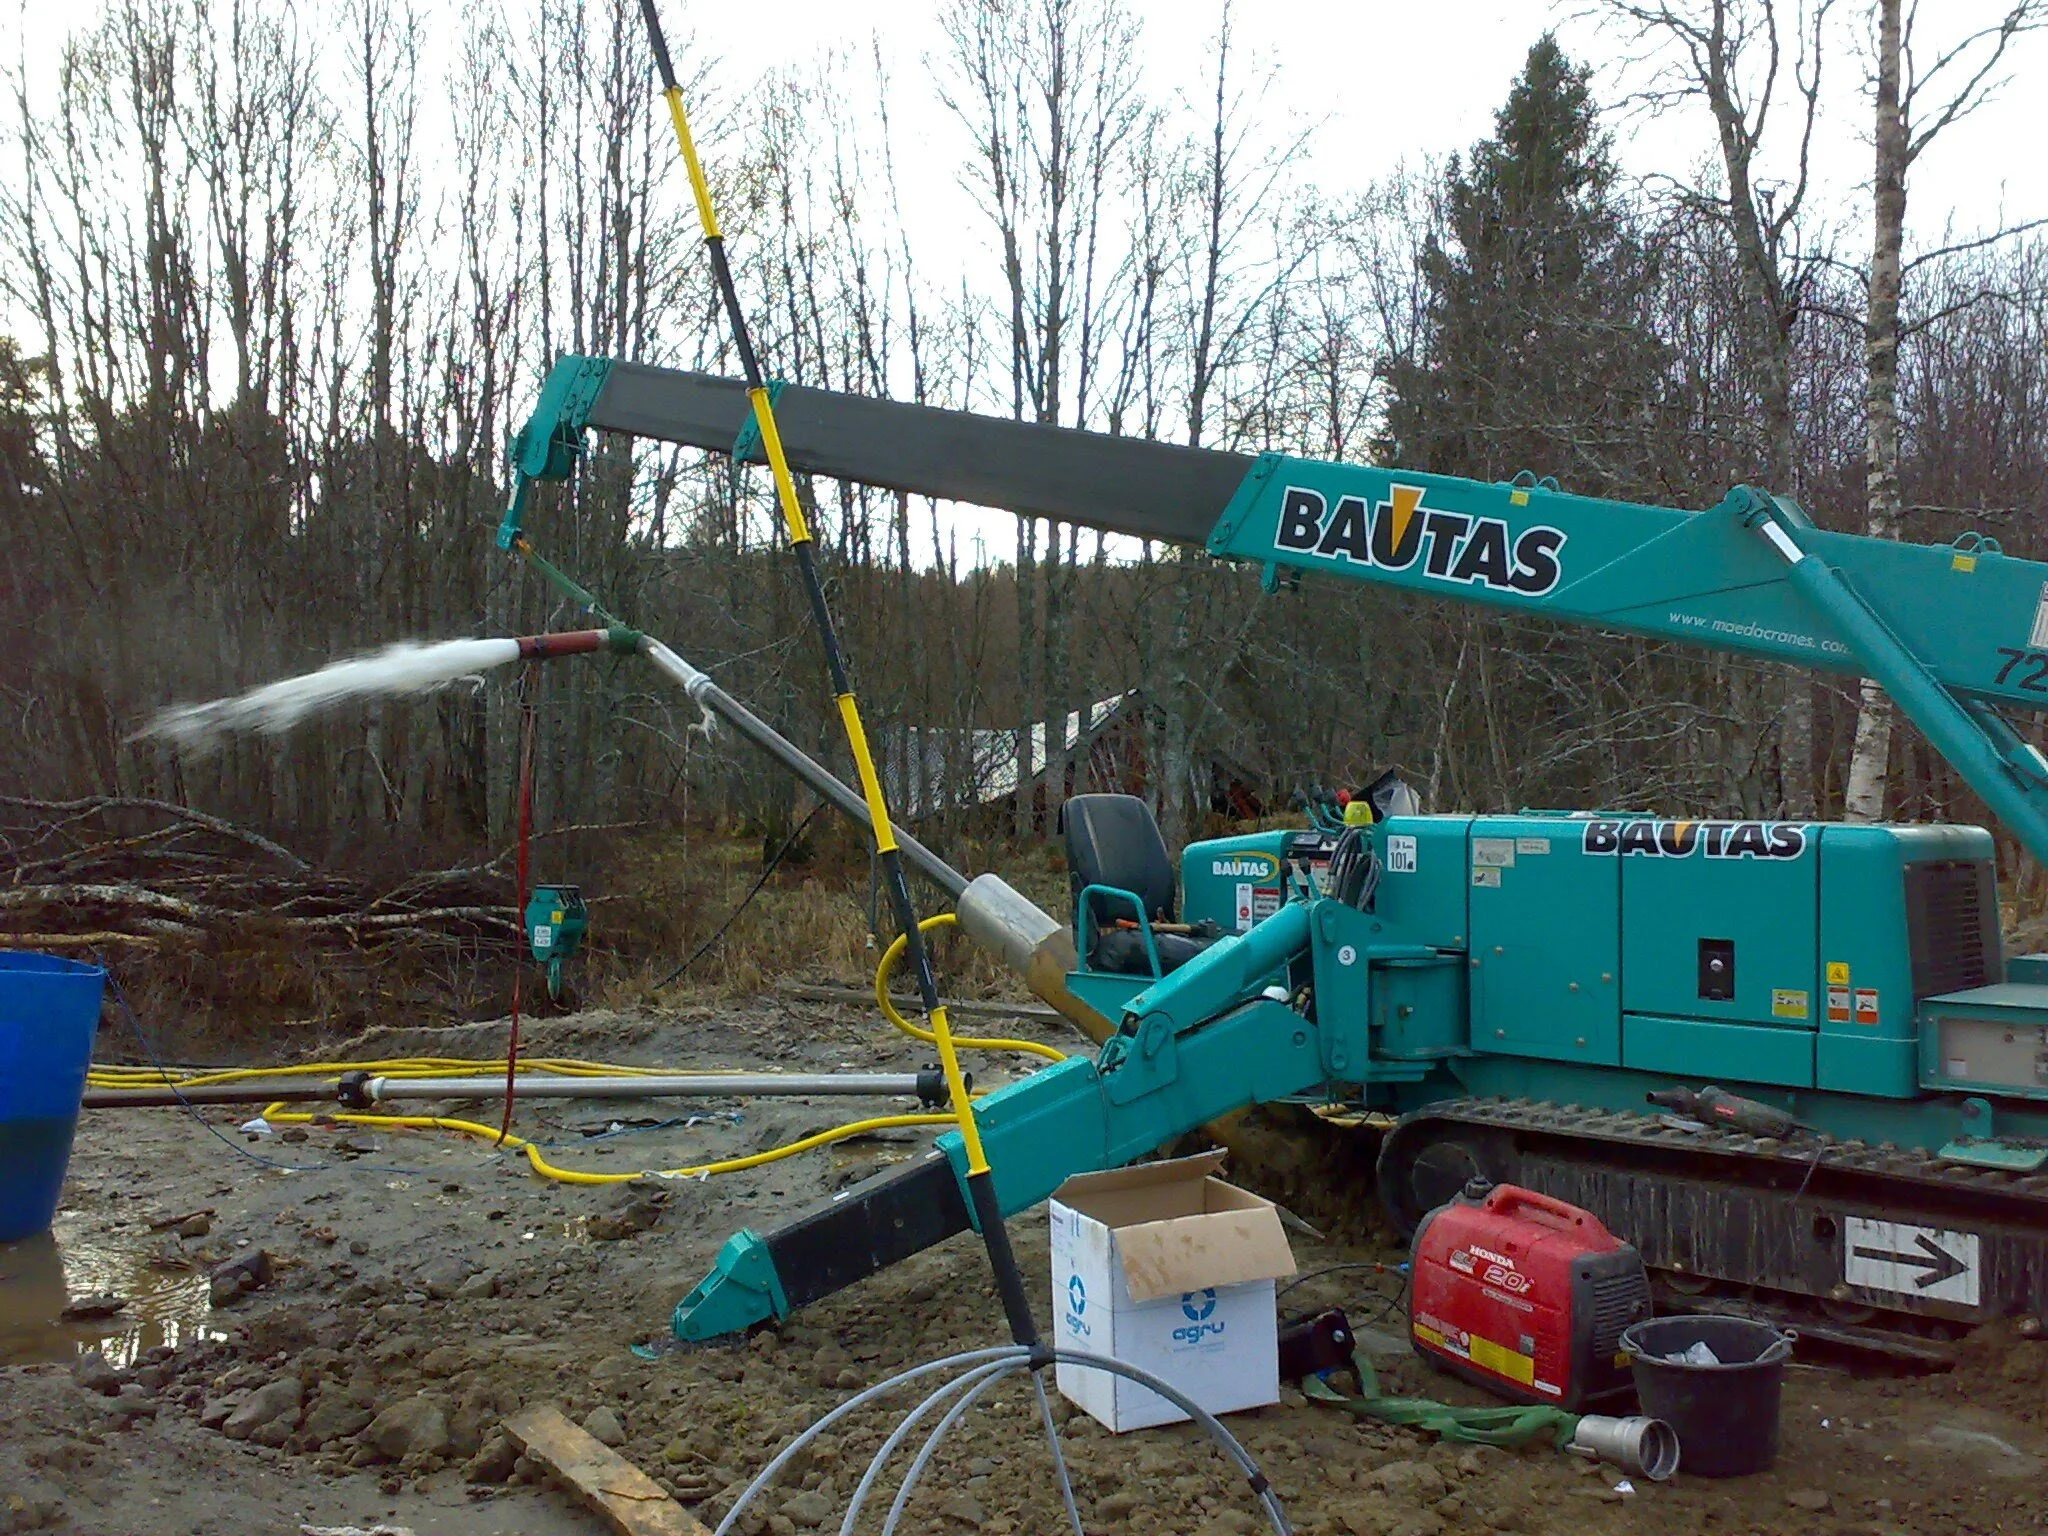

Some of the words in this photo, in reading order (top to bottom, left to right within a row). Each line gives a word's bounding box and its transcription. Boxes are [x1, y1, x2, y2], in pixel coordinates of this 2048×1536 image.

[1275, 483, 1567, 597] BAUTAS
[1582, 820, 1808, 861] BAUTAS
[1212, 860, 1269, 877] BAUTAS
[1390, 851, 1407, 870] 101
[1469, 1244, 1515, 1270] HONDA
[1172, 1321, 1225, 1344] agru
